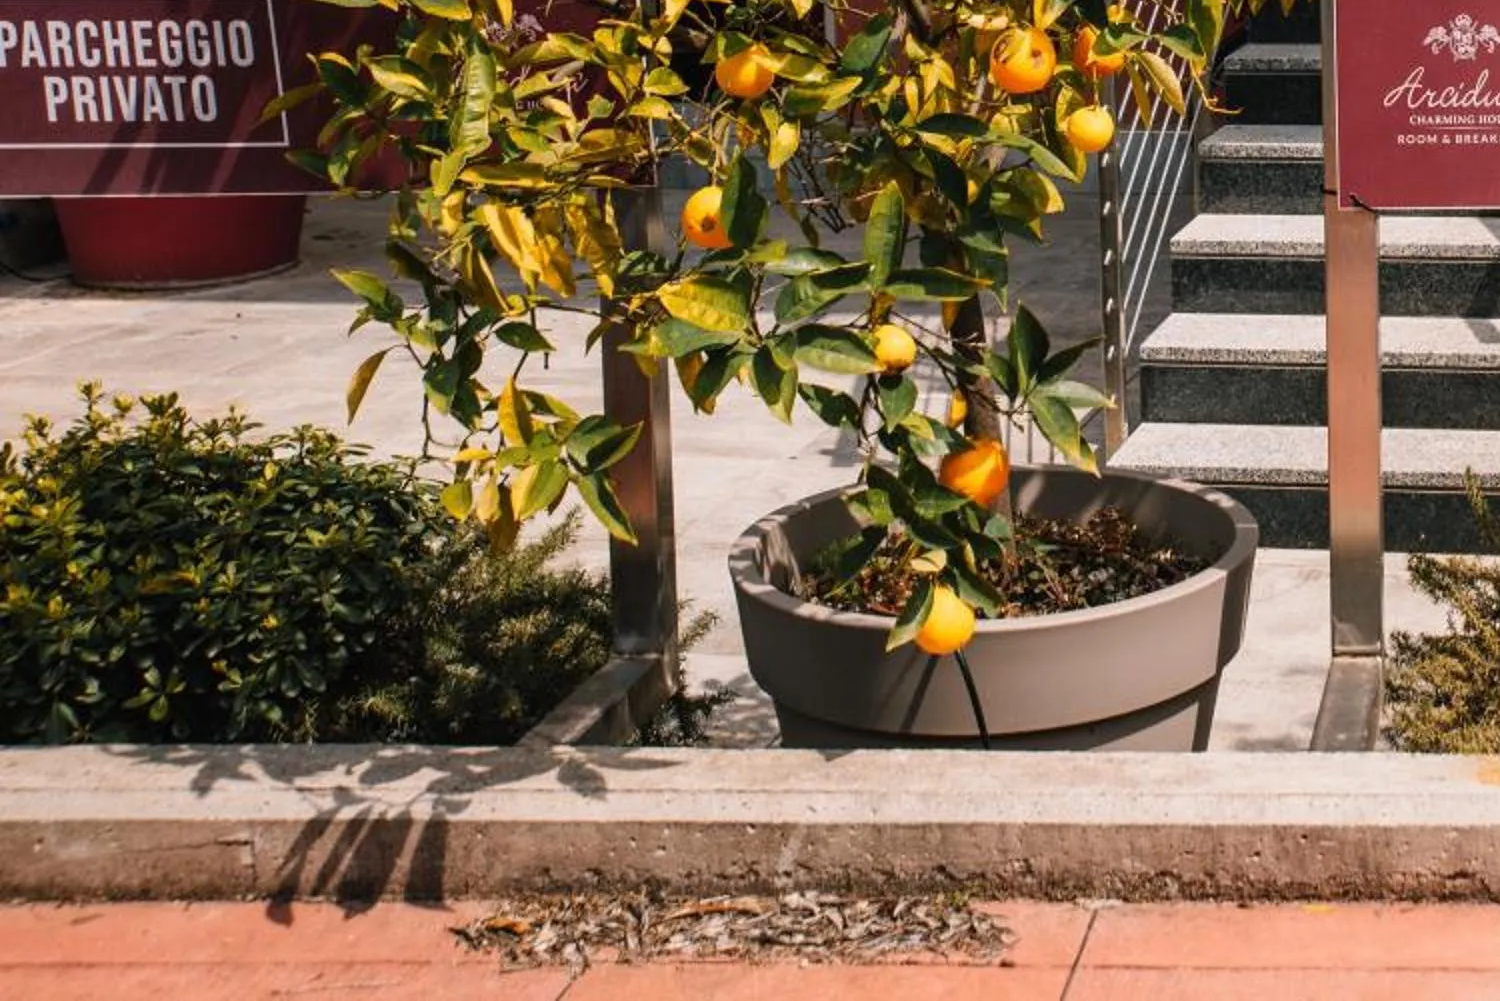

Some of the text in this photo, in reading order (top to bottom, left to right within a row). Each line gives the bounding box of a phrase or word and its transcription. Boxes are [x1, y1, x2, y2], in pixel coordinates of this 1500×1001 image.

[0, 19, 255, 68] PARCHEGGIO
[43, 74, 218, 123] PRIVATO
[1409, 114, 1476, 125] CHARMING
[1397, 134, 1437, 145] ROOM
